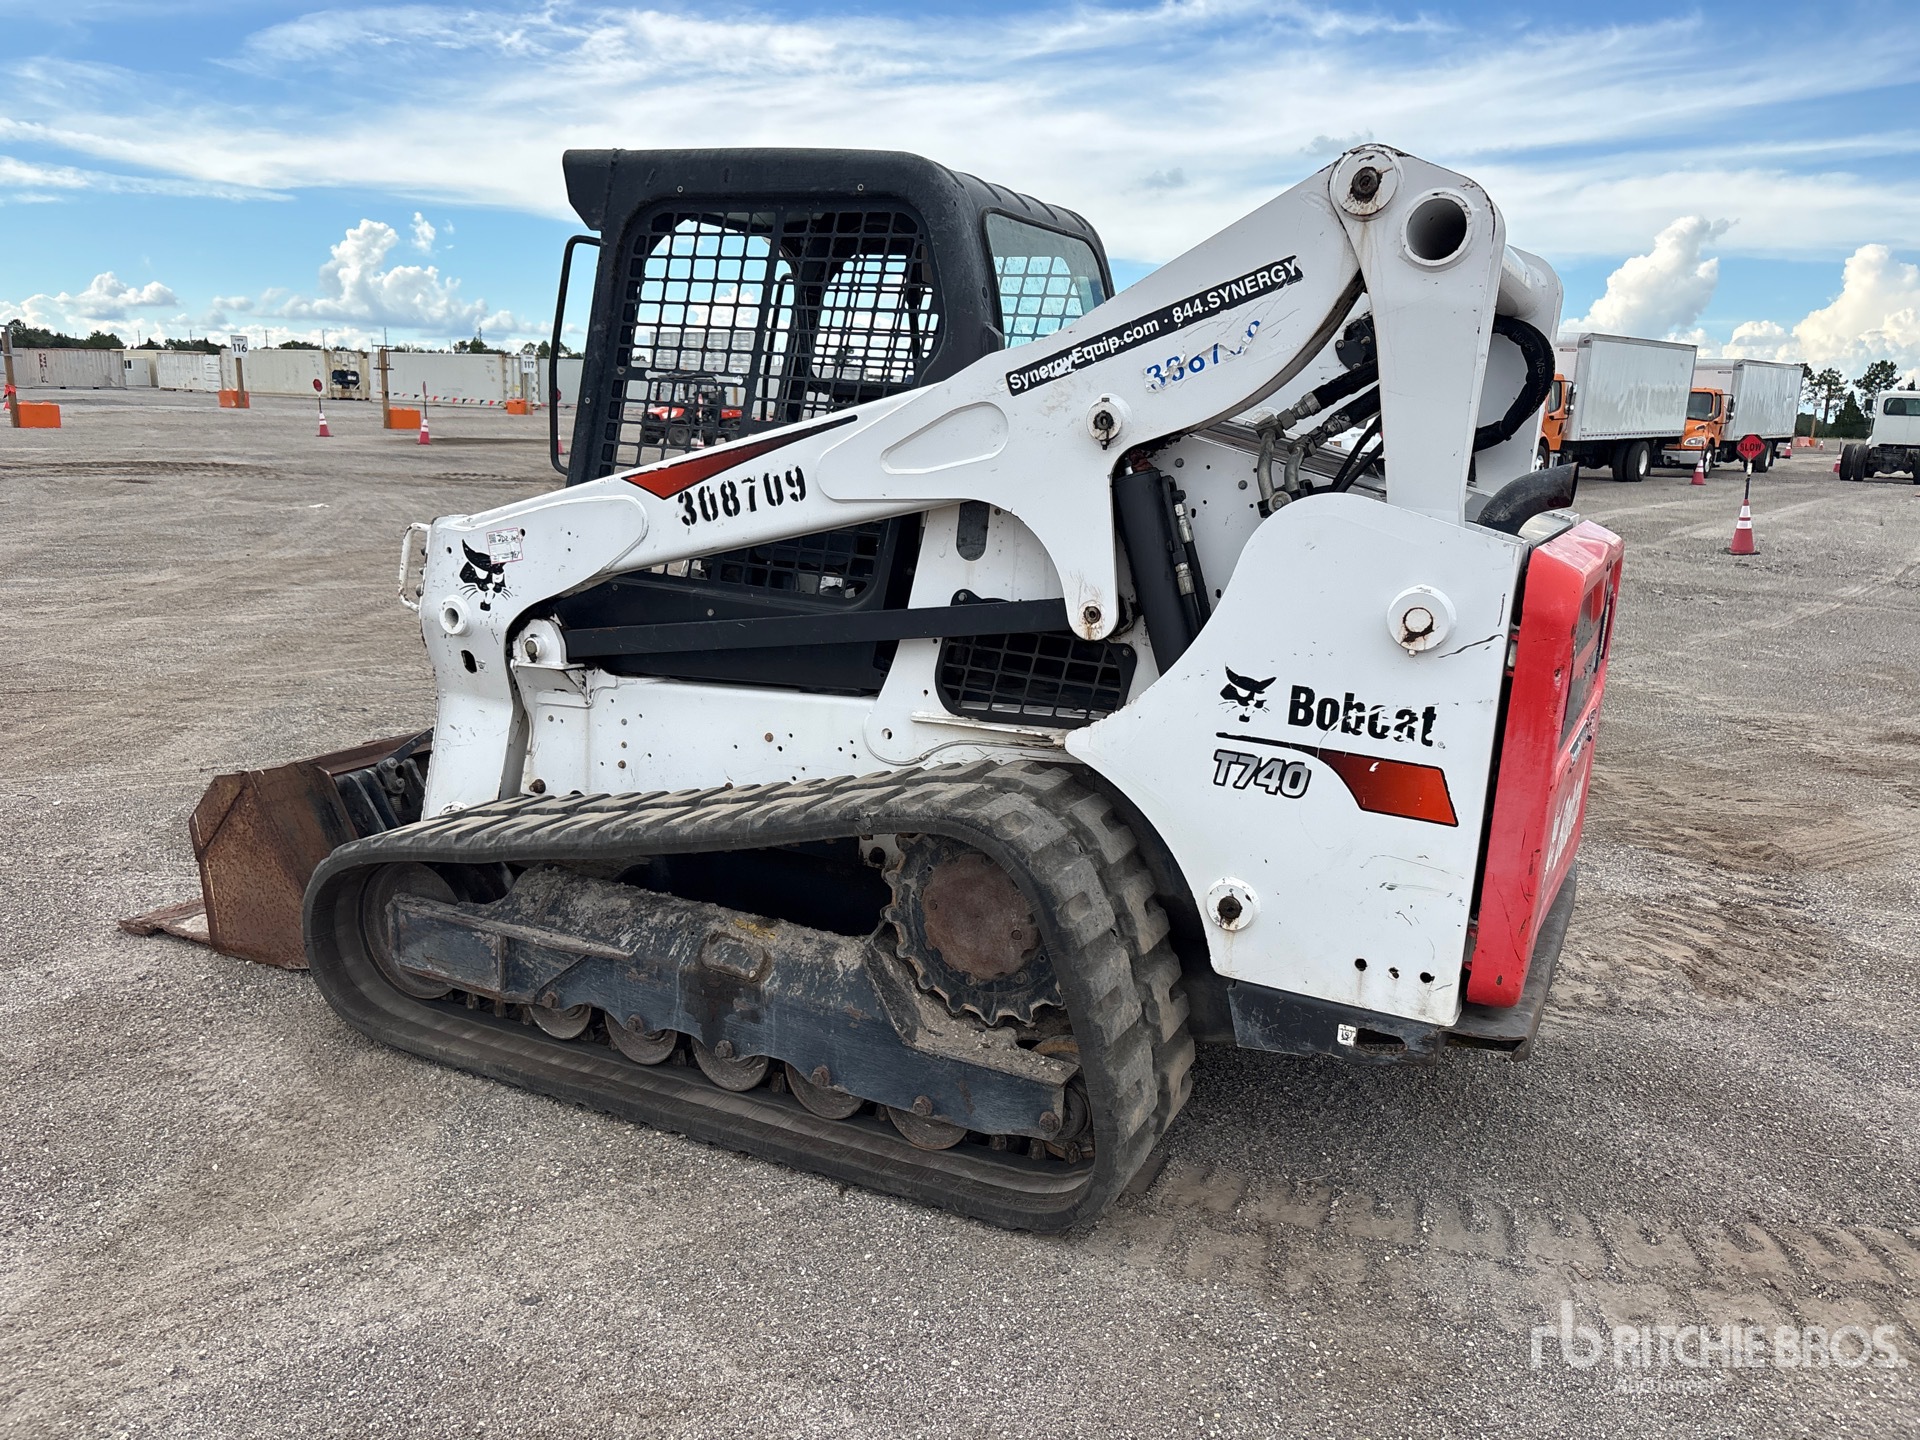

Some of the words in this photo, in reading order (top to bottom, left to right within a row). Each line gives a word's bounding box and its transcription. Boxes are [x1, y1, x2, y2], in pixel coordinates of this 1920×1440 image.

[1172, 261, 1297, 324] 844.SYNERGY
[232, 343, 248, 353] 116
[523, 360, 535, 369] 117
[1740, 442, 1763, 452] SLOW
[677, 465, 807, 527] 308709
[1287, 684, 1438, 747] Bobcat
[1213, 748, 1312, 799] T740
